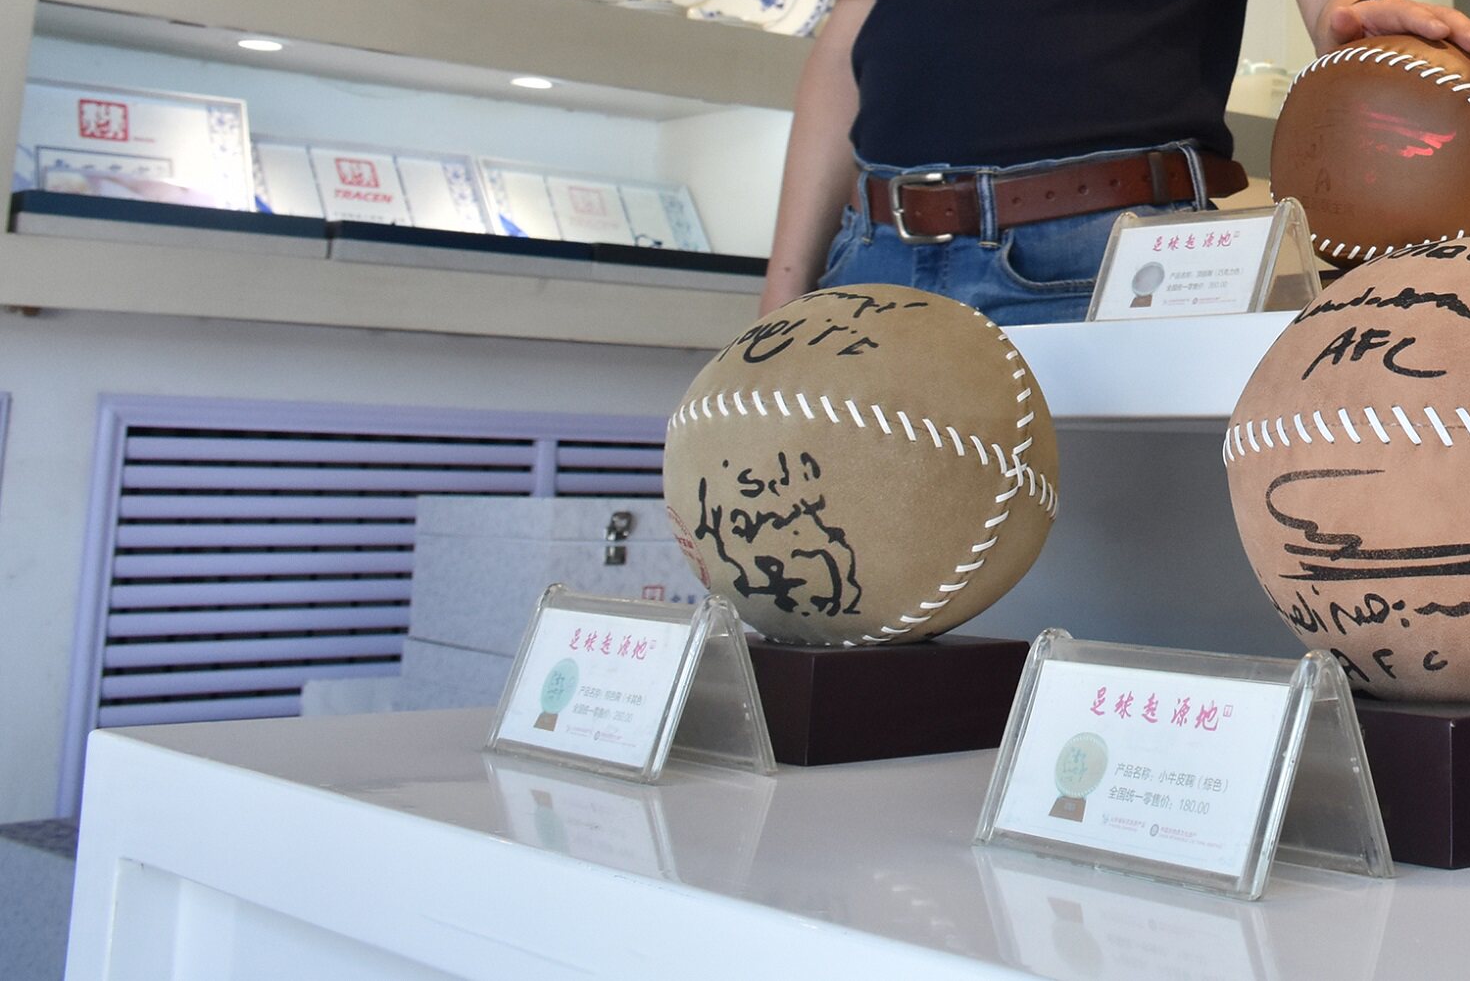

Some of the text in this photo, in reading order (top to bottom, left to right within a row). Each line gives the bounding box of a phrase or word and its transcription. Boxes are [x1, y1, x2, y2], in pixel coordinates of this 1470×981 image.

[334, 189, 393, 204] TRACEN
[1152, 230, 1231, 252] 足球起源地
[1301, 326, 1447, 380] AFC
[568, 628, 648, 661] 足球起源地
[1089, 685, 1219, 732] 足球起源地
